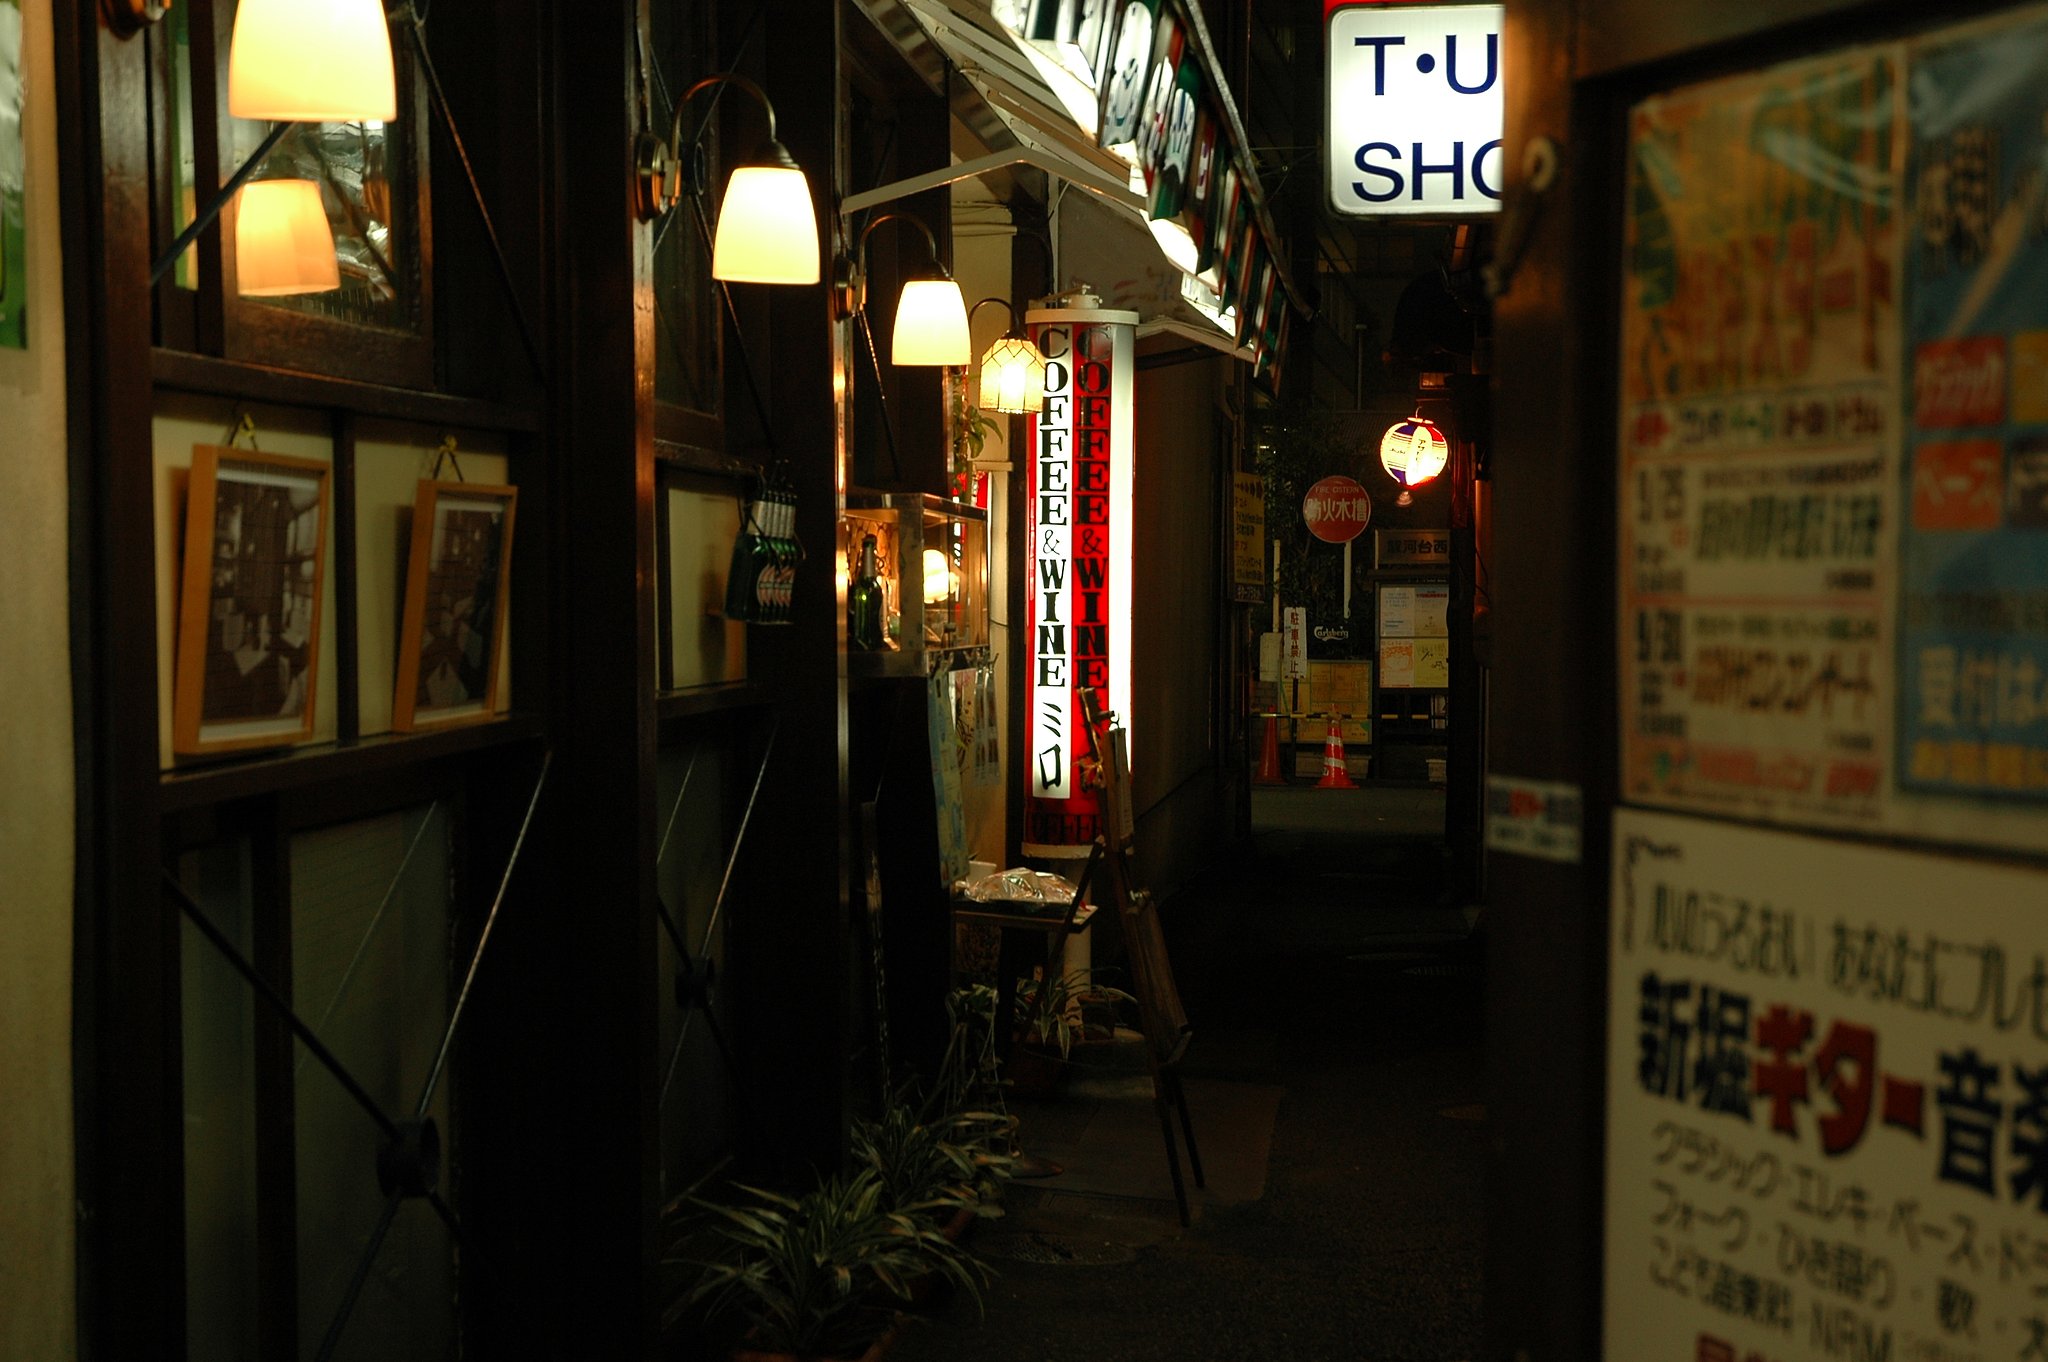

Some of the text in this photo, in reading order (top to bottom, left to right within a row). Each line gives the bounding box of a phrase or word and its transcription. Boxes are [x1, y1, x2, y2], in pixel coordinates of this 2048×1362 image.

[1039, 328, 1069, 526] COFFEE
[1042, 529, 1061, 555] &
[1075, 326, 1111, 689] COFFEE & WINE
[1038, 559, 1067, 687] WINE
[1314, 625, 1349, 642] Carlsberg
